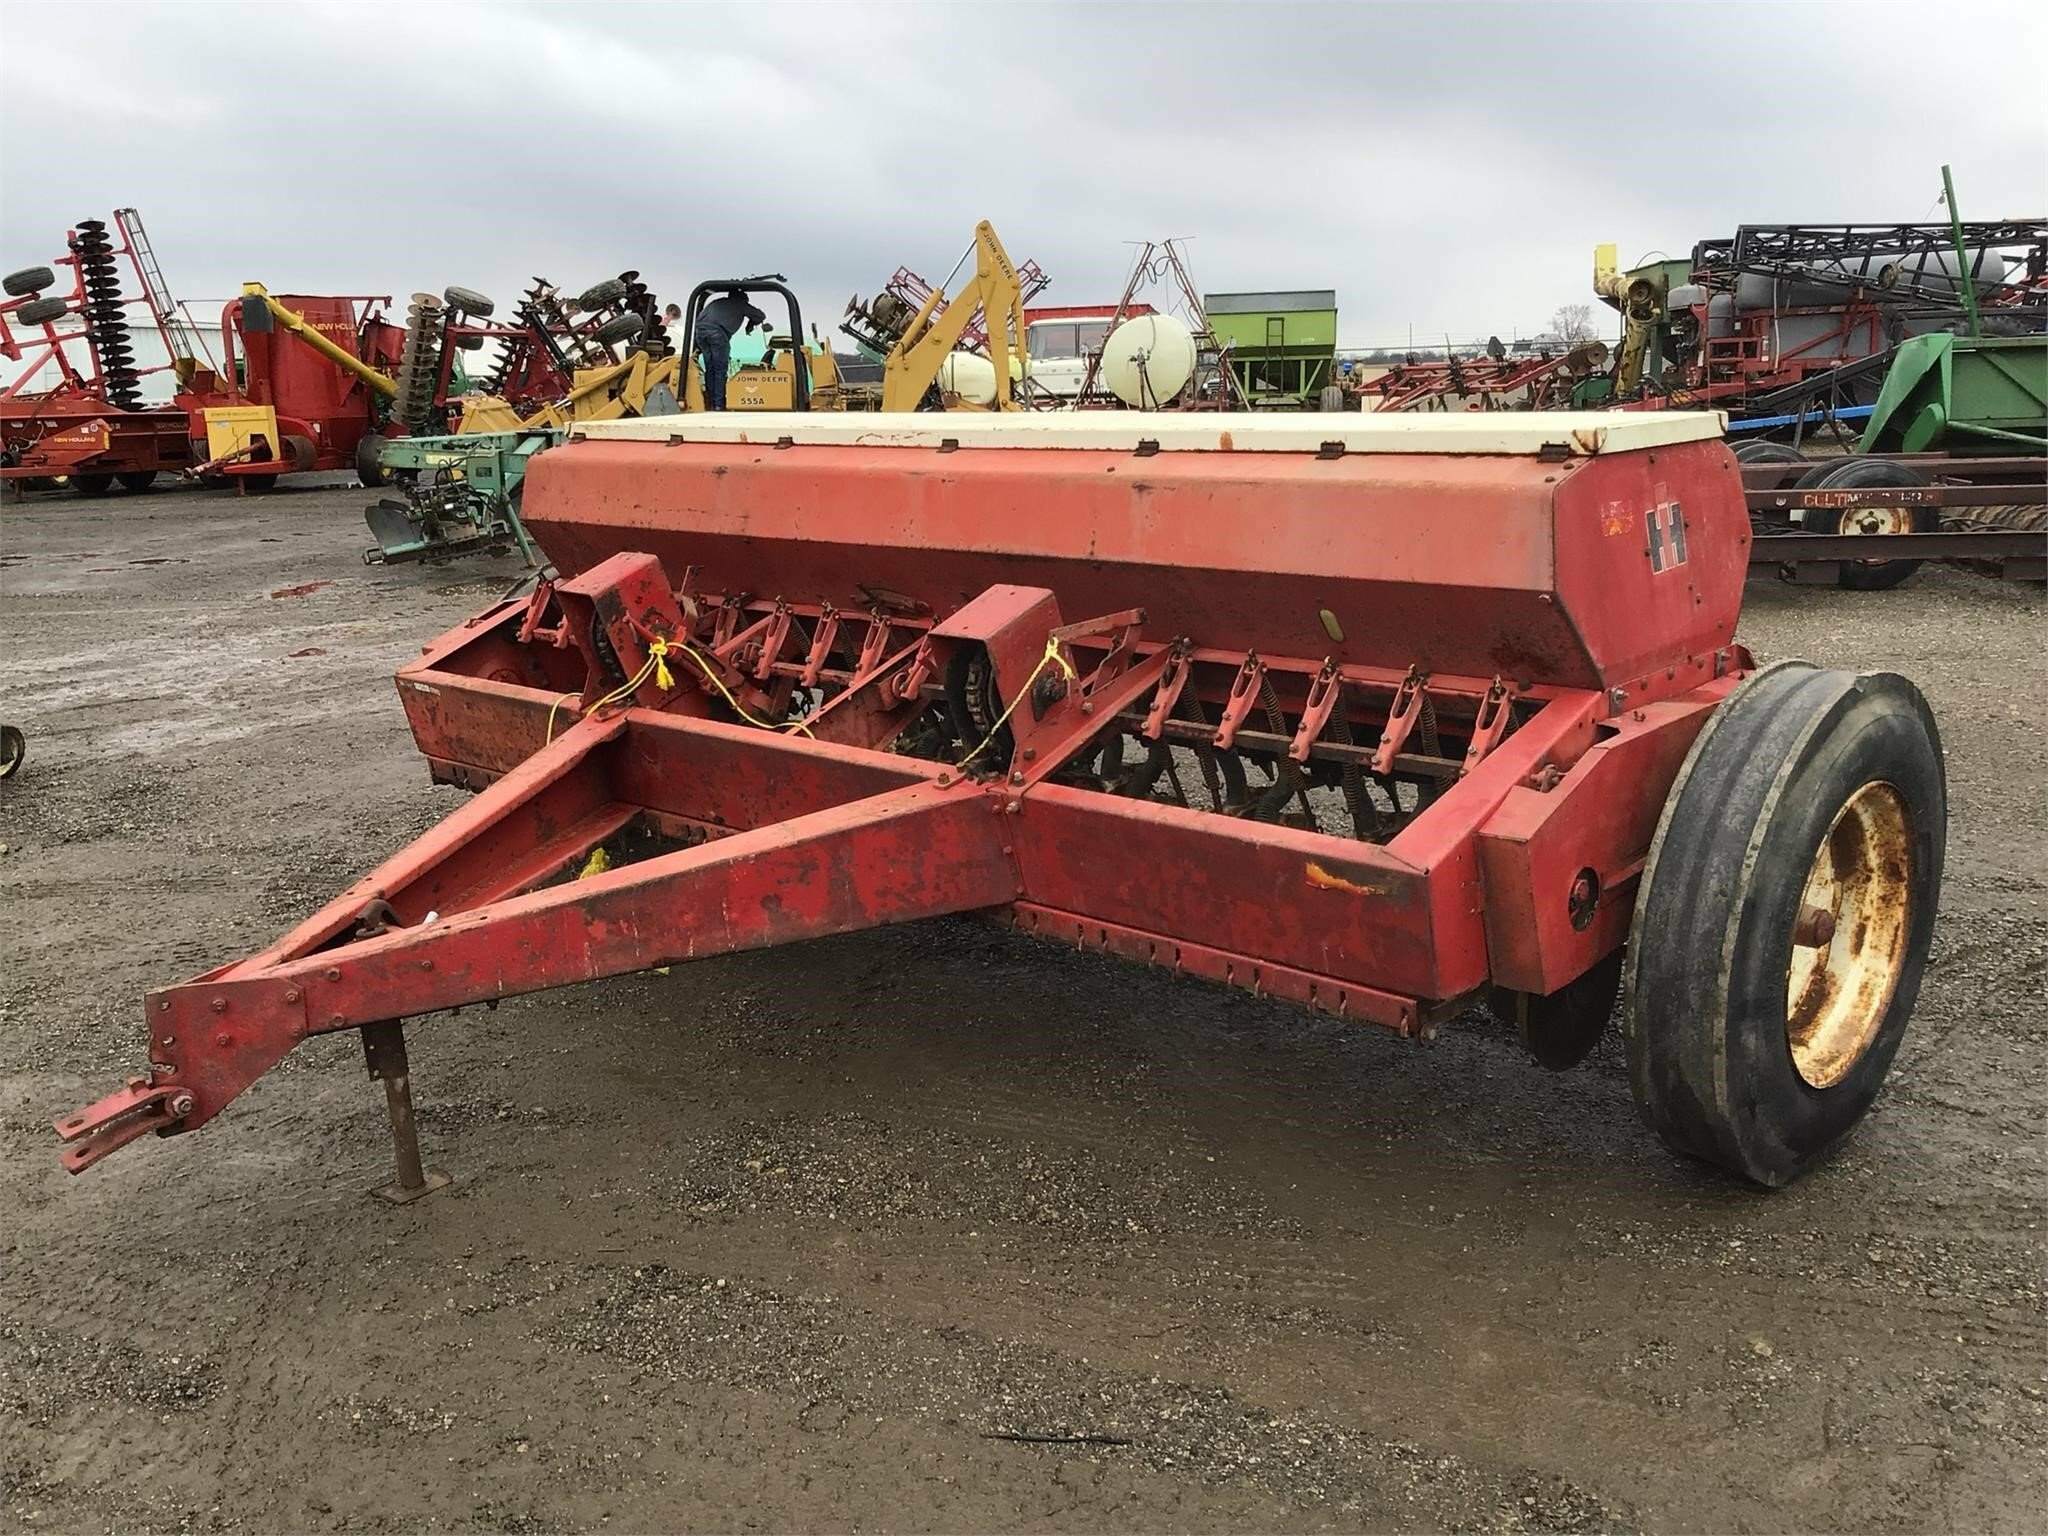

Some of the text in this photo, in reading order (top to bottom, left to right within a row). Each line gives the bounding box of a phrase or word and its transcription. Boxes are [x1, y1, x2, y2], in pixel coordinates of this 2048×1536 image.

[983, 232, 1013, 280] JOHN DEERE
[312, 323, 334, 331] NEW
[740, 397, 765, 405] 555A
